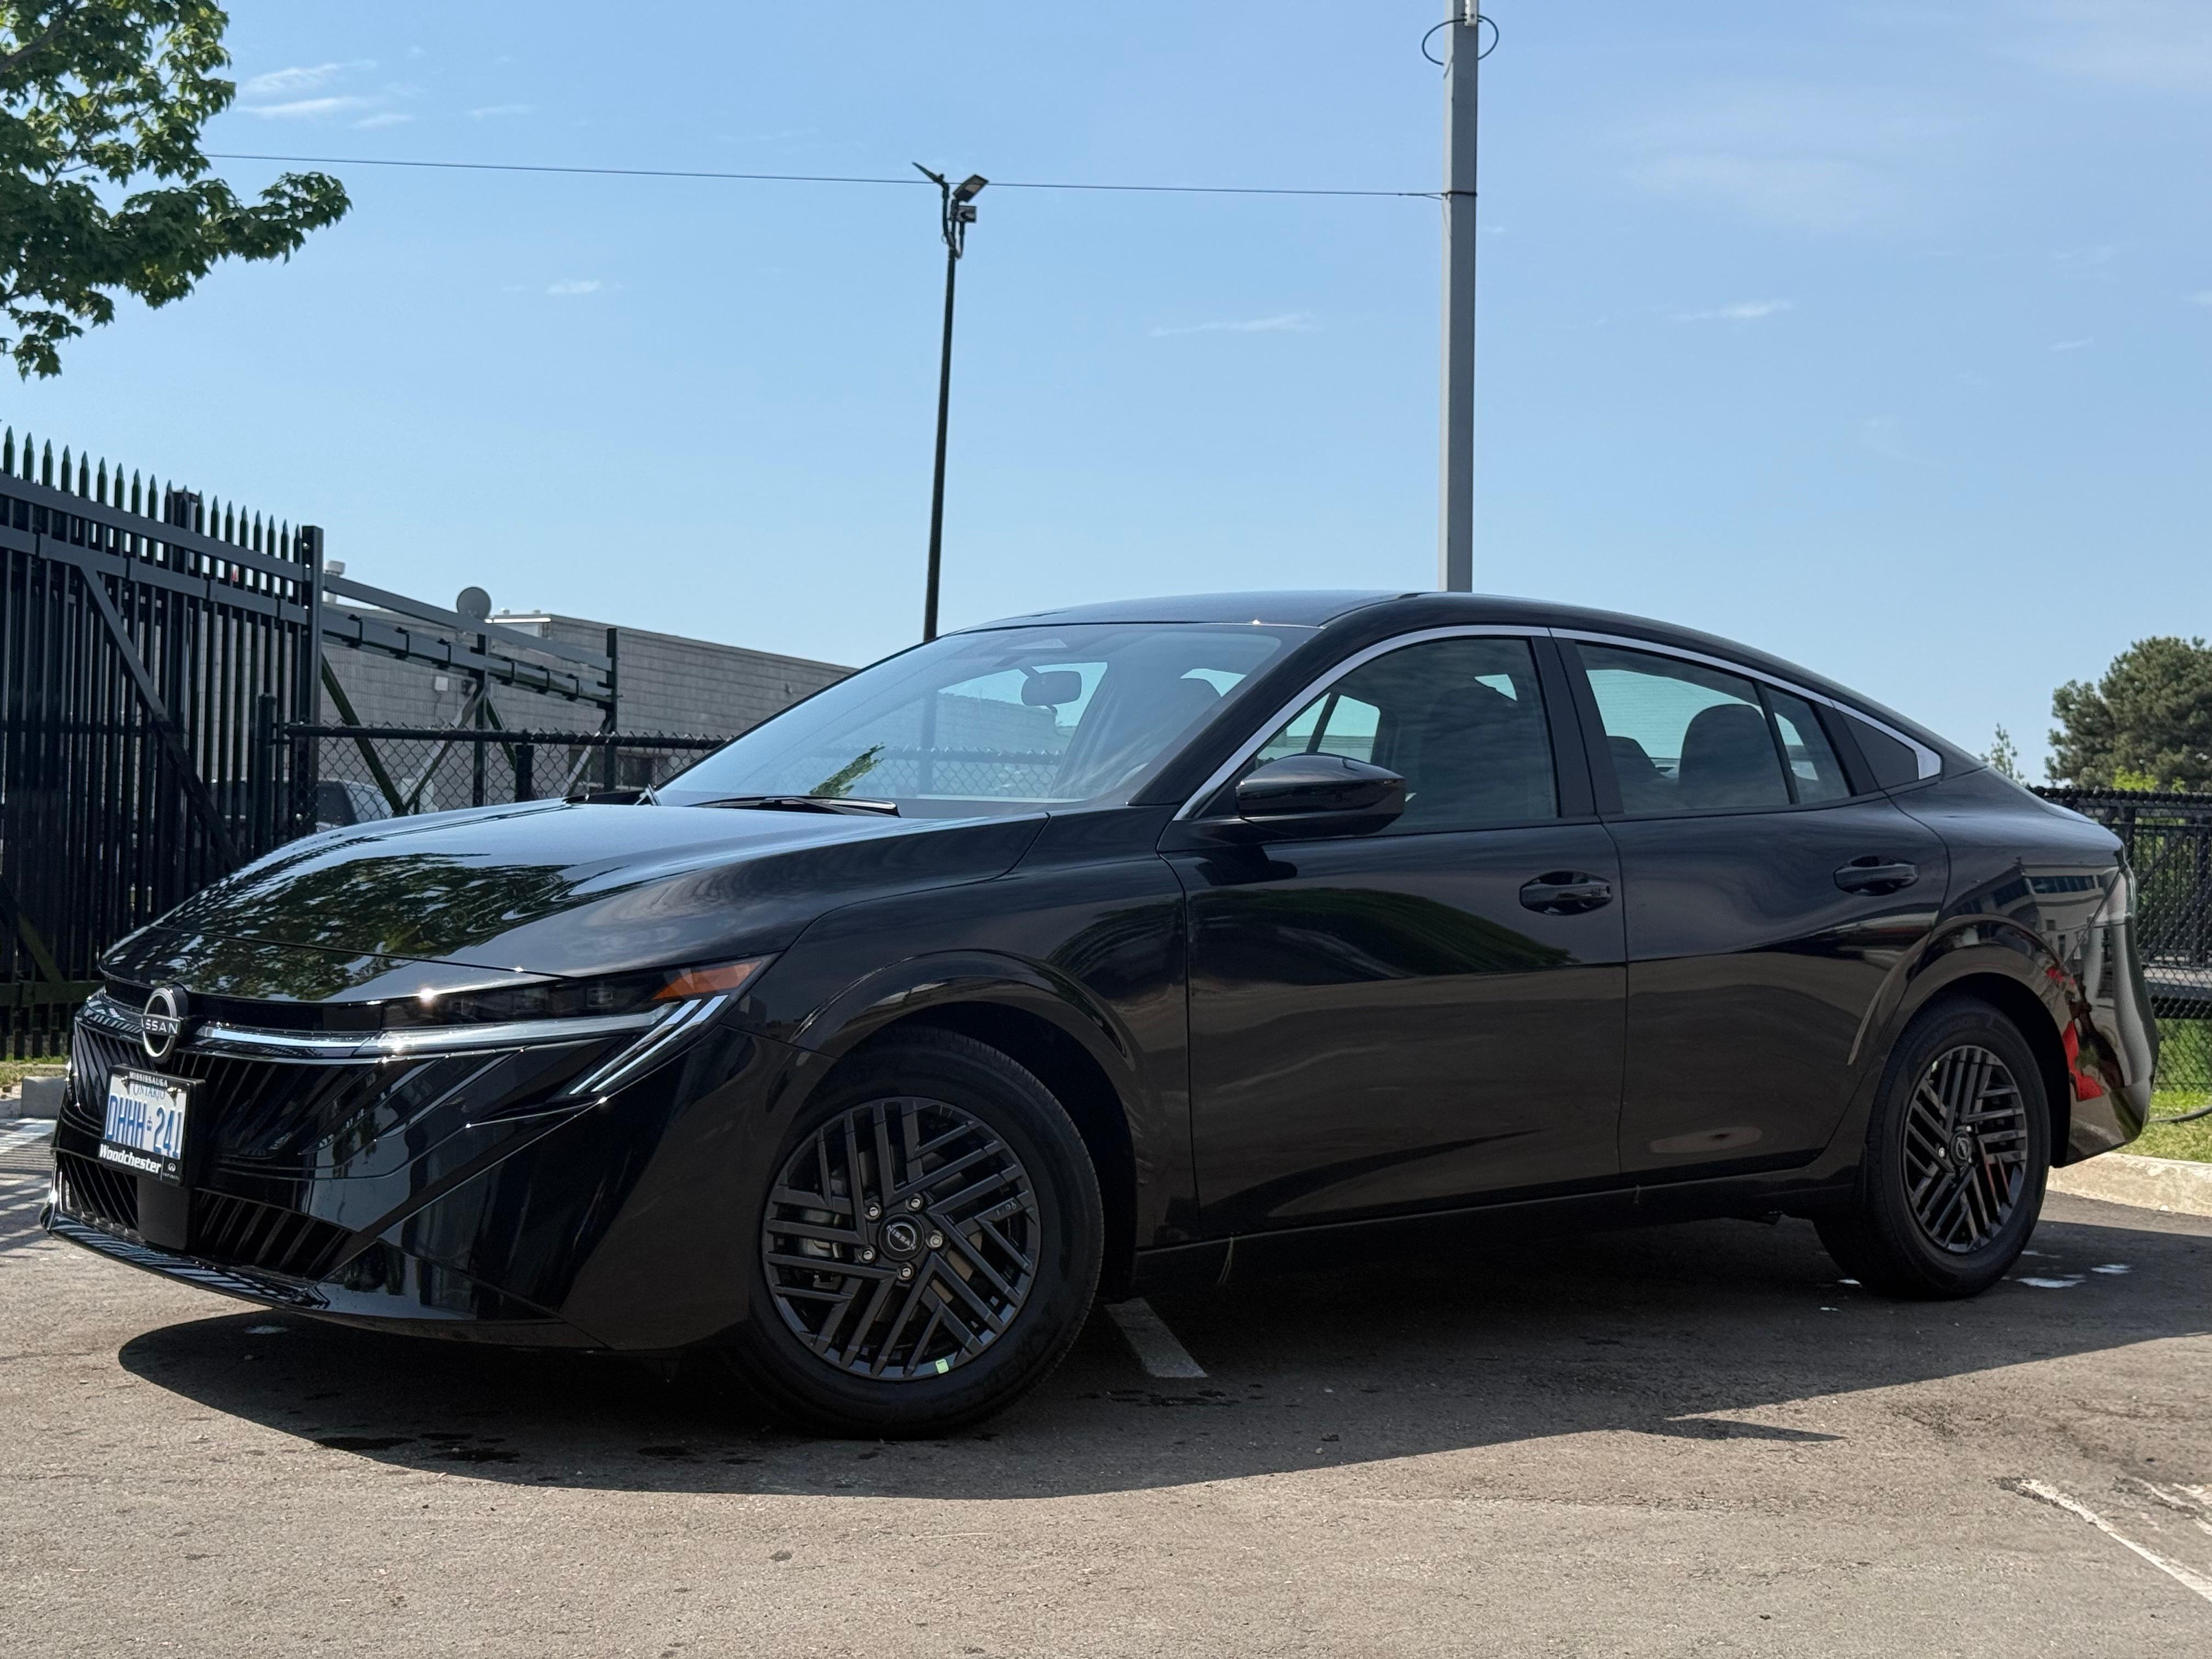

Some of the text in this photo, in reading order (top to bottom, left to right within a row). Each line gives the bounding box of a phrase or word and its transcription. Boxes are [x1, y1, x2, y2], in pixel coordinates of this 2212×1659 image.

[145, 1019, 178, 1034] SSAN
[129, 1071, 168, 1088] MISSISSAUGA
[133, 1084, 166, 1101] ONTARIO
[105, 1095, 183, 1160] DHHH 241
[99, 1143, 162, 1174] Woodchester
[886, 1224, 917, 1251] NISSAN
